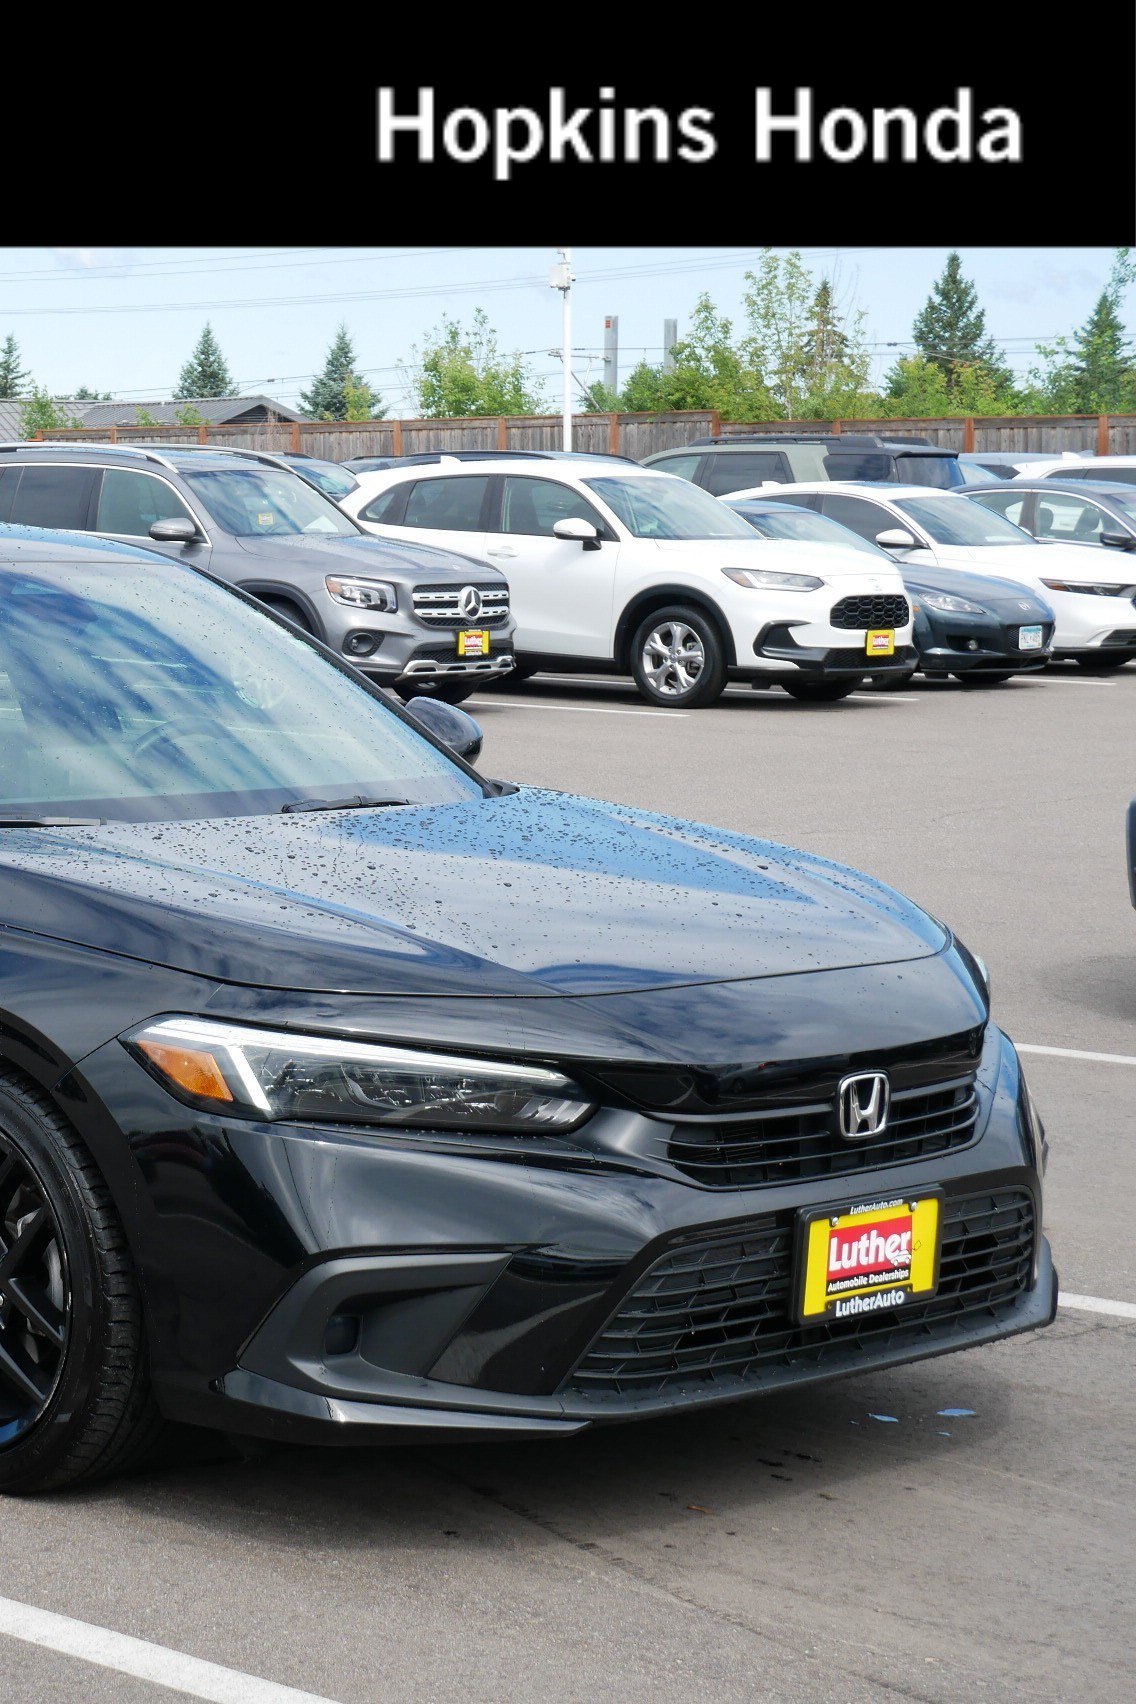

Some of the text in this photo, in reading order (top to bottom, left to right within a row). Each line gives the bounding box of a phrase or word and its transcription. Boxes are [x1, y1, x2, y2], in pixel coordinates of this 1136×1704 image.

[850, 1199, 903, 1215] LutherAuto.com
[829, 1229, 912, 1271] Luther
[827, 1268, 909, 1293] Automobile Dealerships
[835, 1289, 905, 1318] LutherAuto
